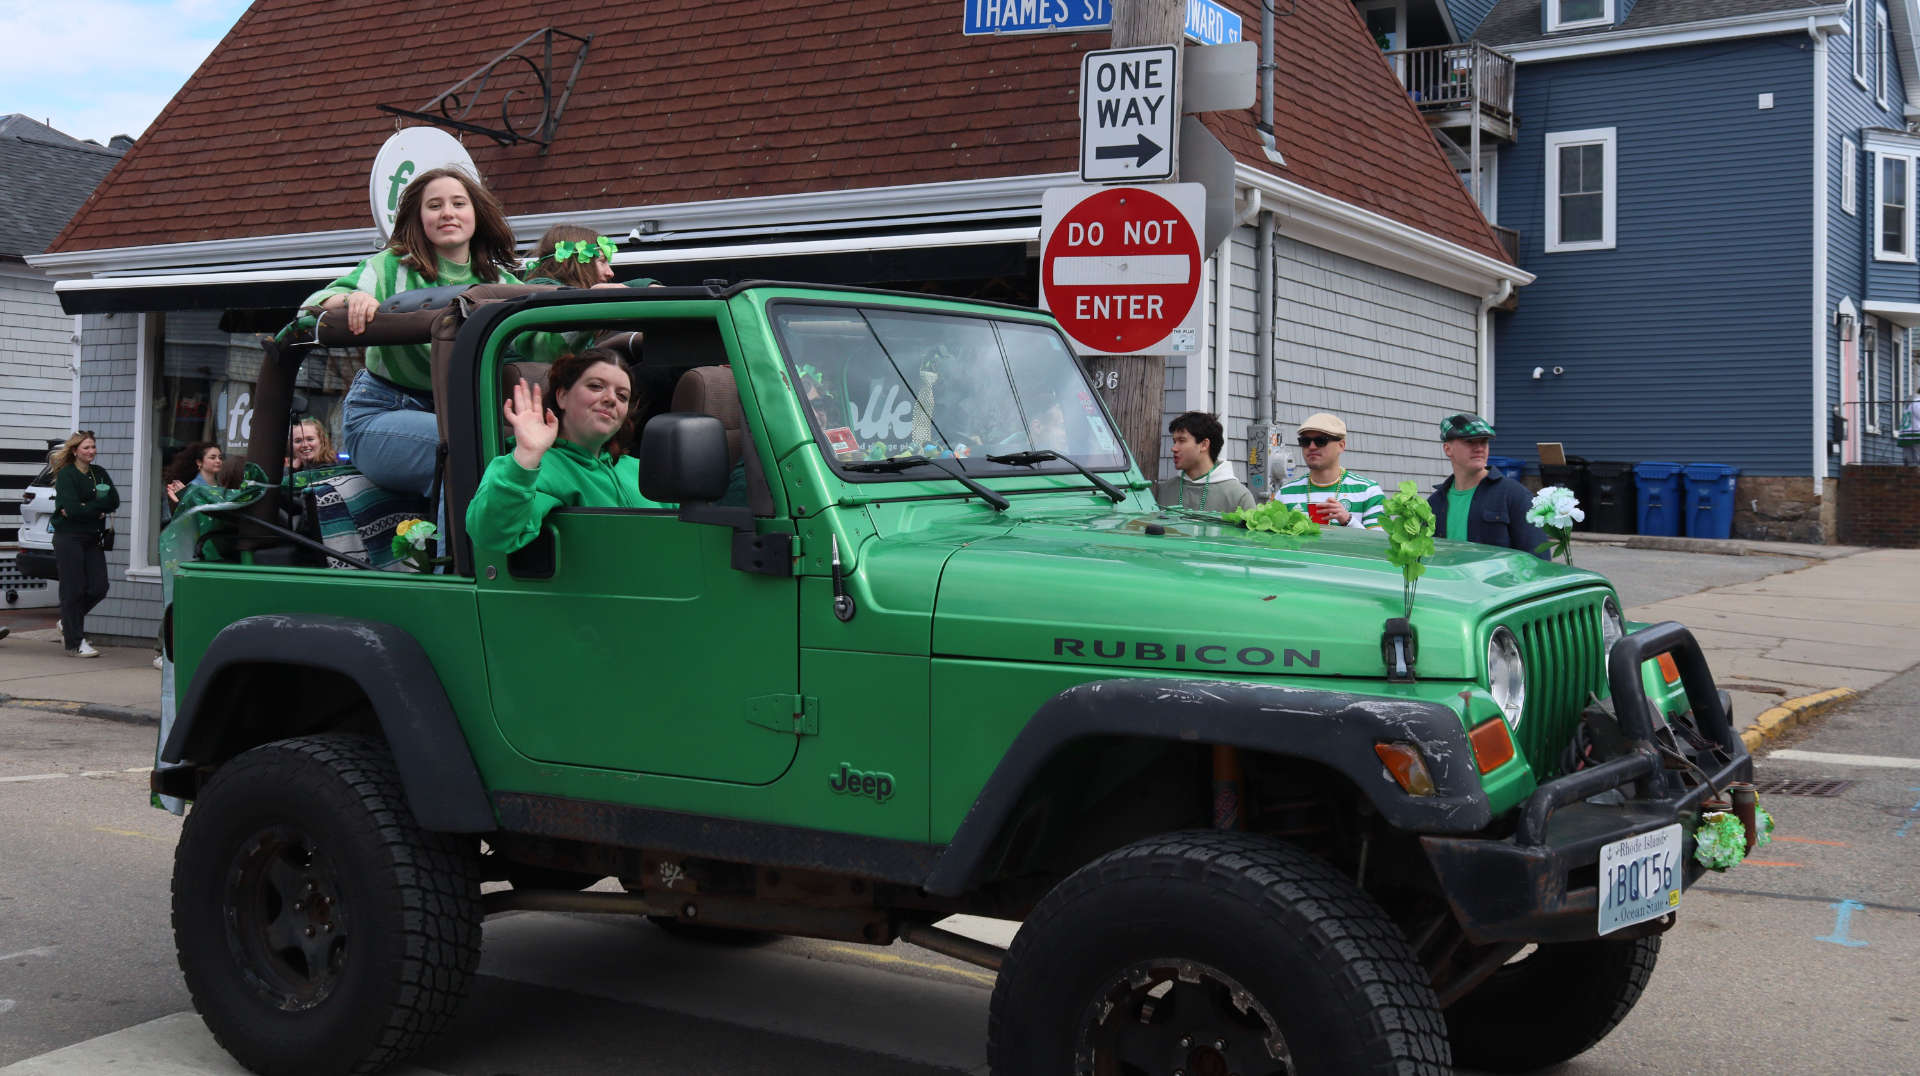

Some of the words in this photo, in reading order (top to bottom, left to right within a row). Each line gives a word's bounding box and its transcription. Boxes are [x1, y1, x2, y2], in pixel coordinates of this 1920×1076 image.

[975, 0, 1069, 29] THAMES
[1096, 59, 1163, 93] ONE
[1096, 95, 1165, 129] WAY
[1067, 222, 1104, 247] DO
[1123, 220, 1178, 246] NOT
[1075, 295, 1164, 320] ENTER
[1053, 637, 1321, 668] RUBICON
[830, 766, 894, 801] Jeep
[1620, 841, 1642, 858] Rhode
[1643, 831, 1665, 850] Island
[1608, 850, 1671, 909] 1BQ156
[1621, 905, 1645, 920] Ocean
[1647, 899, 1664, 913] State
